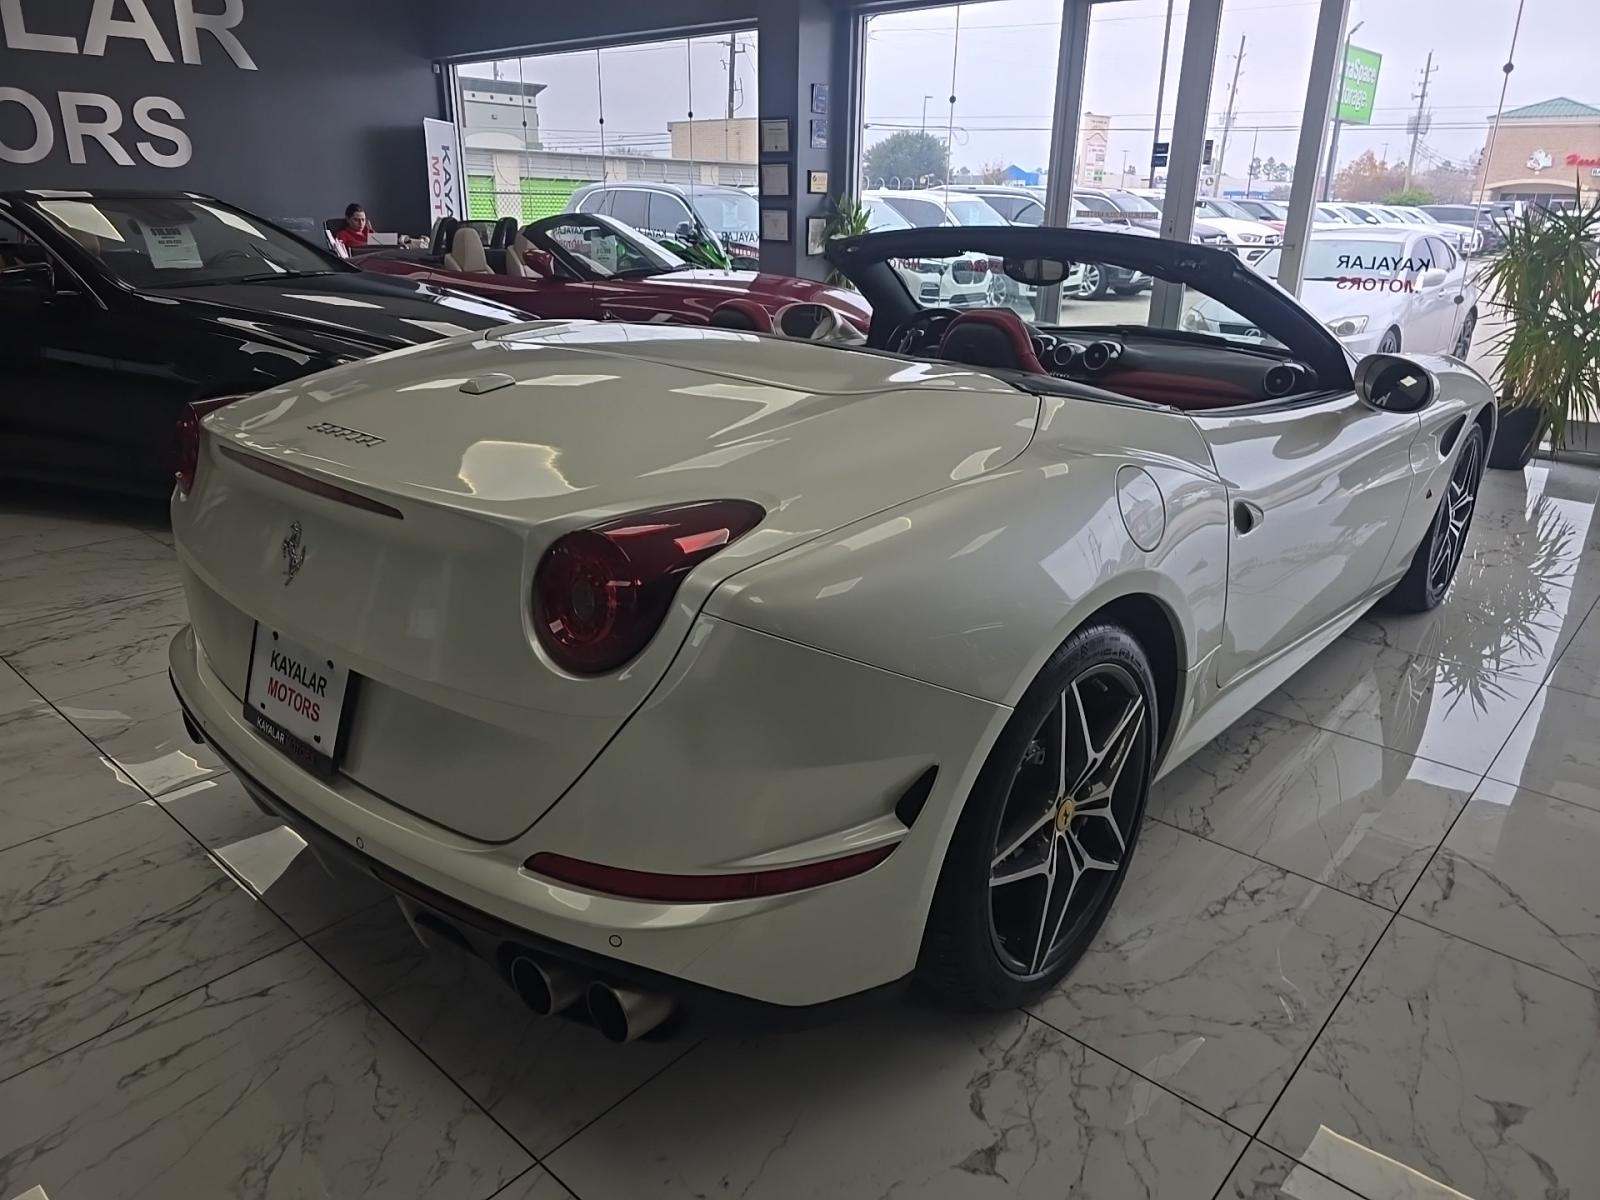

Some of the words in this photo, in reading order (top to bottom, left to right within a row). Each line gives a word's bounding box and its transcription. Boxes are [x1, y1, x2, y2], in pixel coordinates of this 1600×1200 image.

[0, 86, 193, 168] ORS
[270, 650, 328, 698] KAYALAR
[267, 676, 321, 722] MOTORS
[256, 715, 286, 744] KAYALAR
